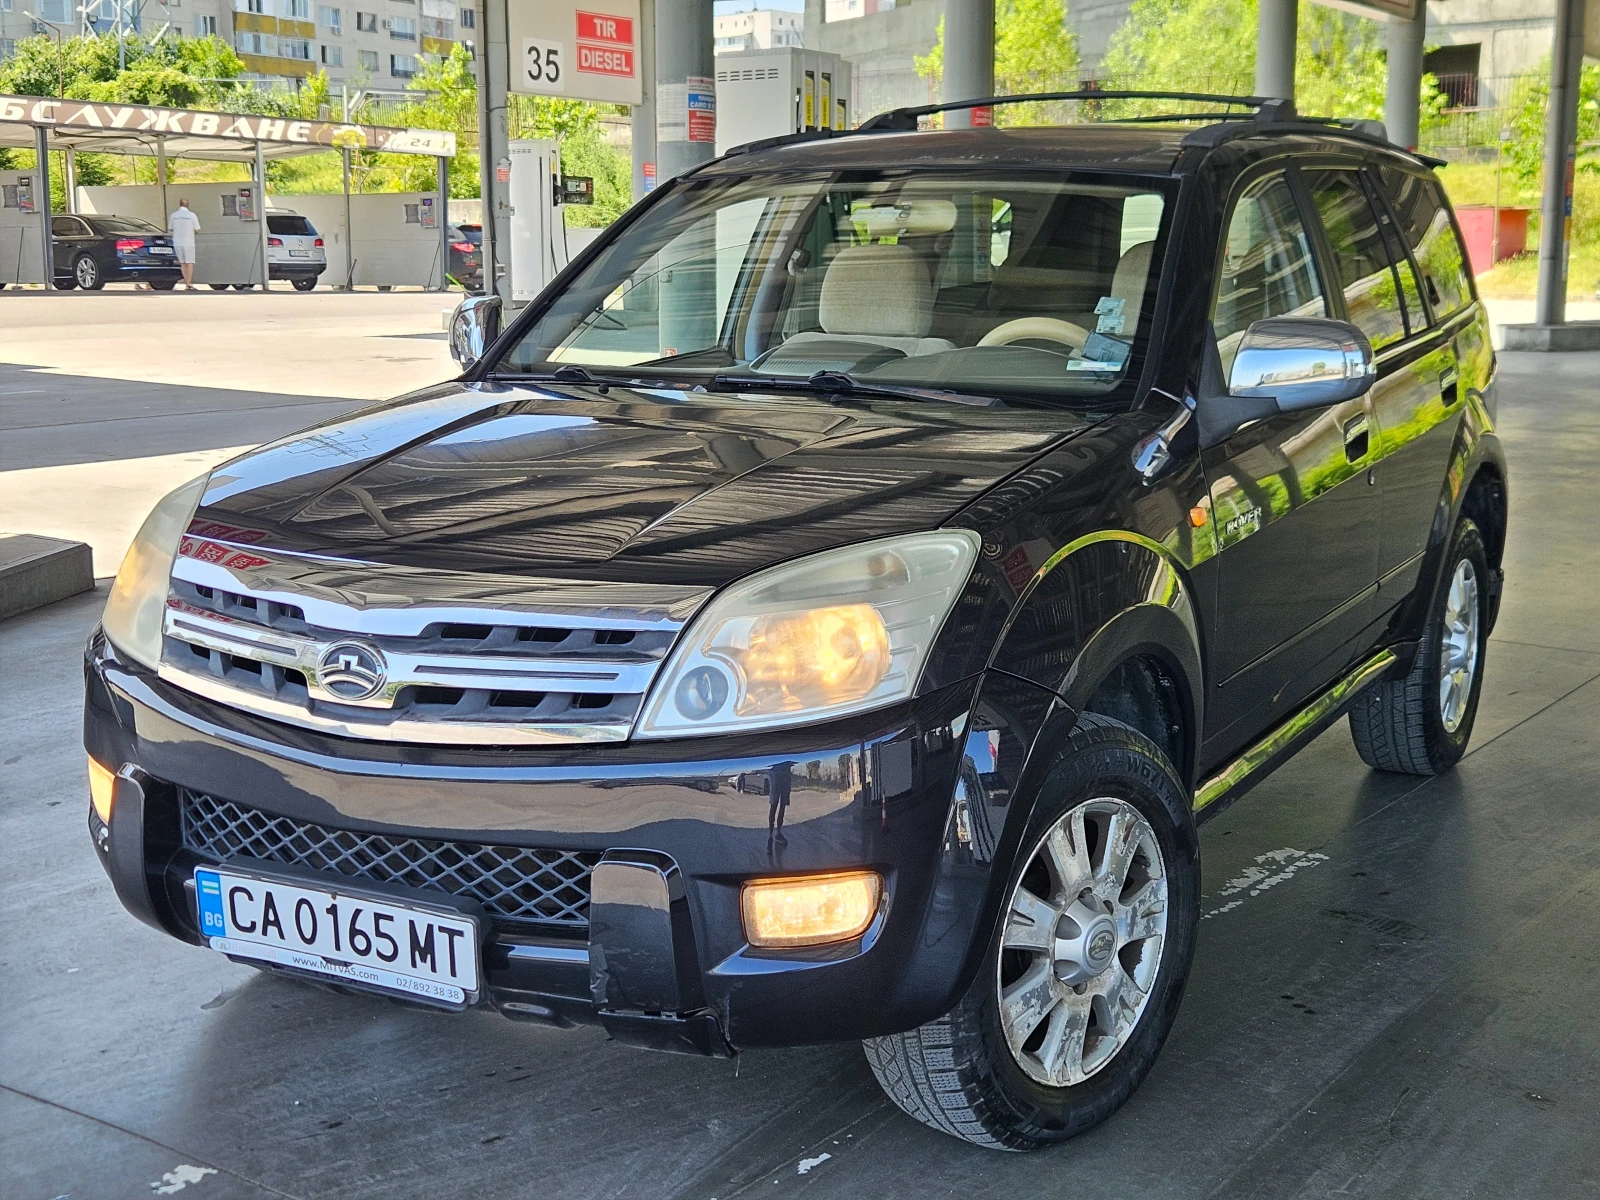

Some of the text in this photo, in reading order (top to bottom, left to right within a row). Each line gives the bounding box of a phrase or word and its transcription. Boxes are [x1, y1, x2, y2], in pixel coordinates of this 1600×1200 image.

[593, 17, 617, 39] TIR
[527, 45, 560, 83] 35
[580, 49, 631, 72] DIESEL
[205, 911, 223, 928] BG
[433, 986, 445, 996] 38
[447, 989, 459, 1000] 38
